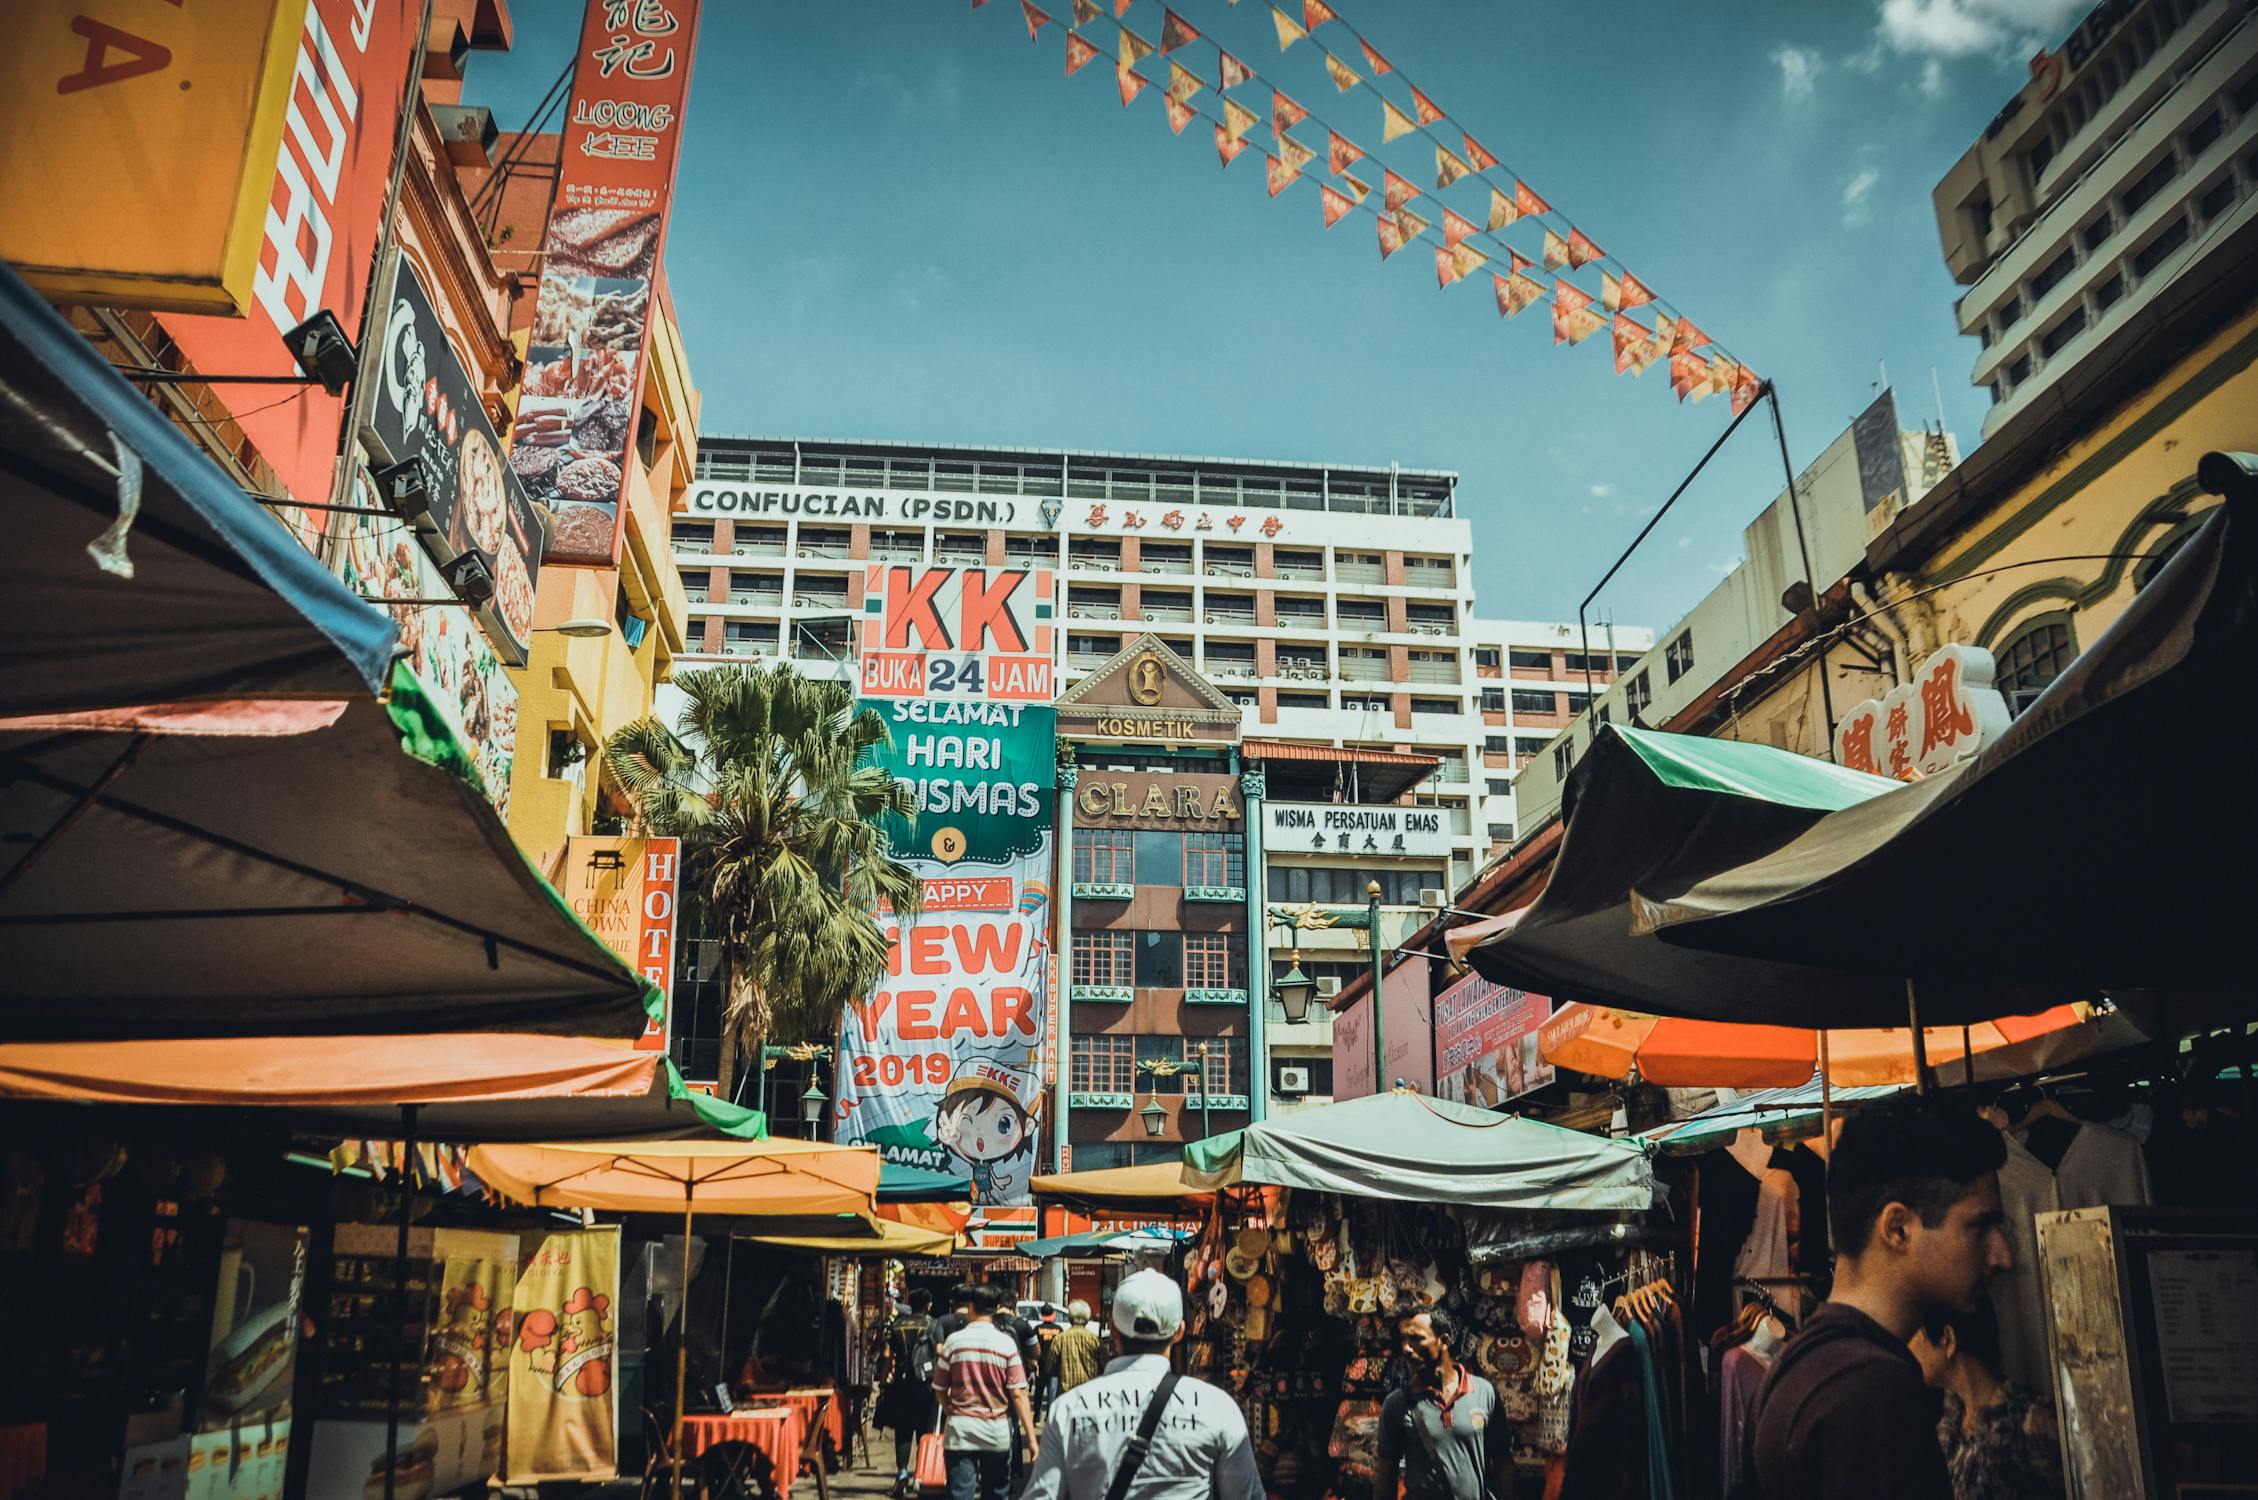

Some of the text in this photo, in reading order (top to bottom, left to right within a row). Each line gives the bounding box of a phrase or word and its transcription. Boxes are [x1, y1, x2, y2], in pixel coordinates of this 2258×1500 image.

[573, 99, 675, 132] LOONG
[580, 131, 659, 161] KEE
[885, 565, 1030, 653] KK
[865, 658, 1048, 694] BUKA 24 JAM
[892, 700, 1026, 728] SELAMAT
[1097, 718, 1195, 738] KOSMETIK
[906, 734, 1002, 770] HARI
[1079, 781, 1241, 820] CLARA
[1275, 809, 1439, 832] WISMA PERSATUAN EMAS
[943, 837, 956, 853] &
[574, 898, 631, 914] CHINA
[922, 884, 988, 903] APPY
[582, 915, 629, 932] OWN
[852, 986, 1037, 1042] YEAR
[853, 1052, 951, 1087] 2019
